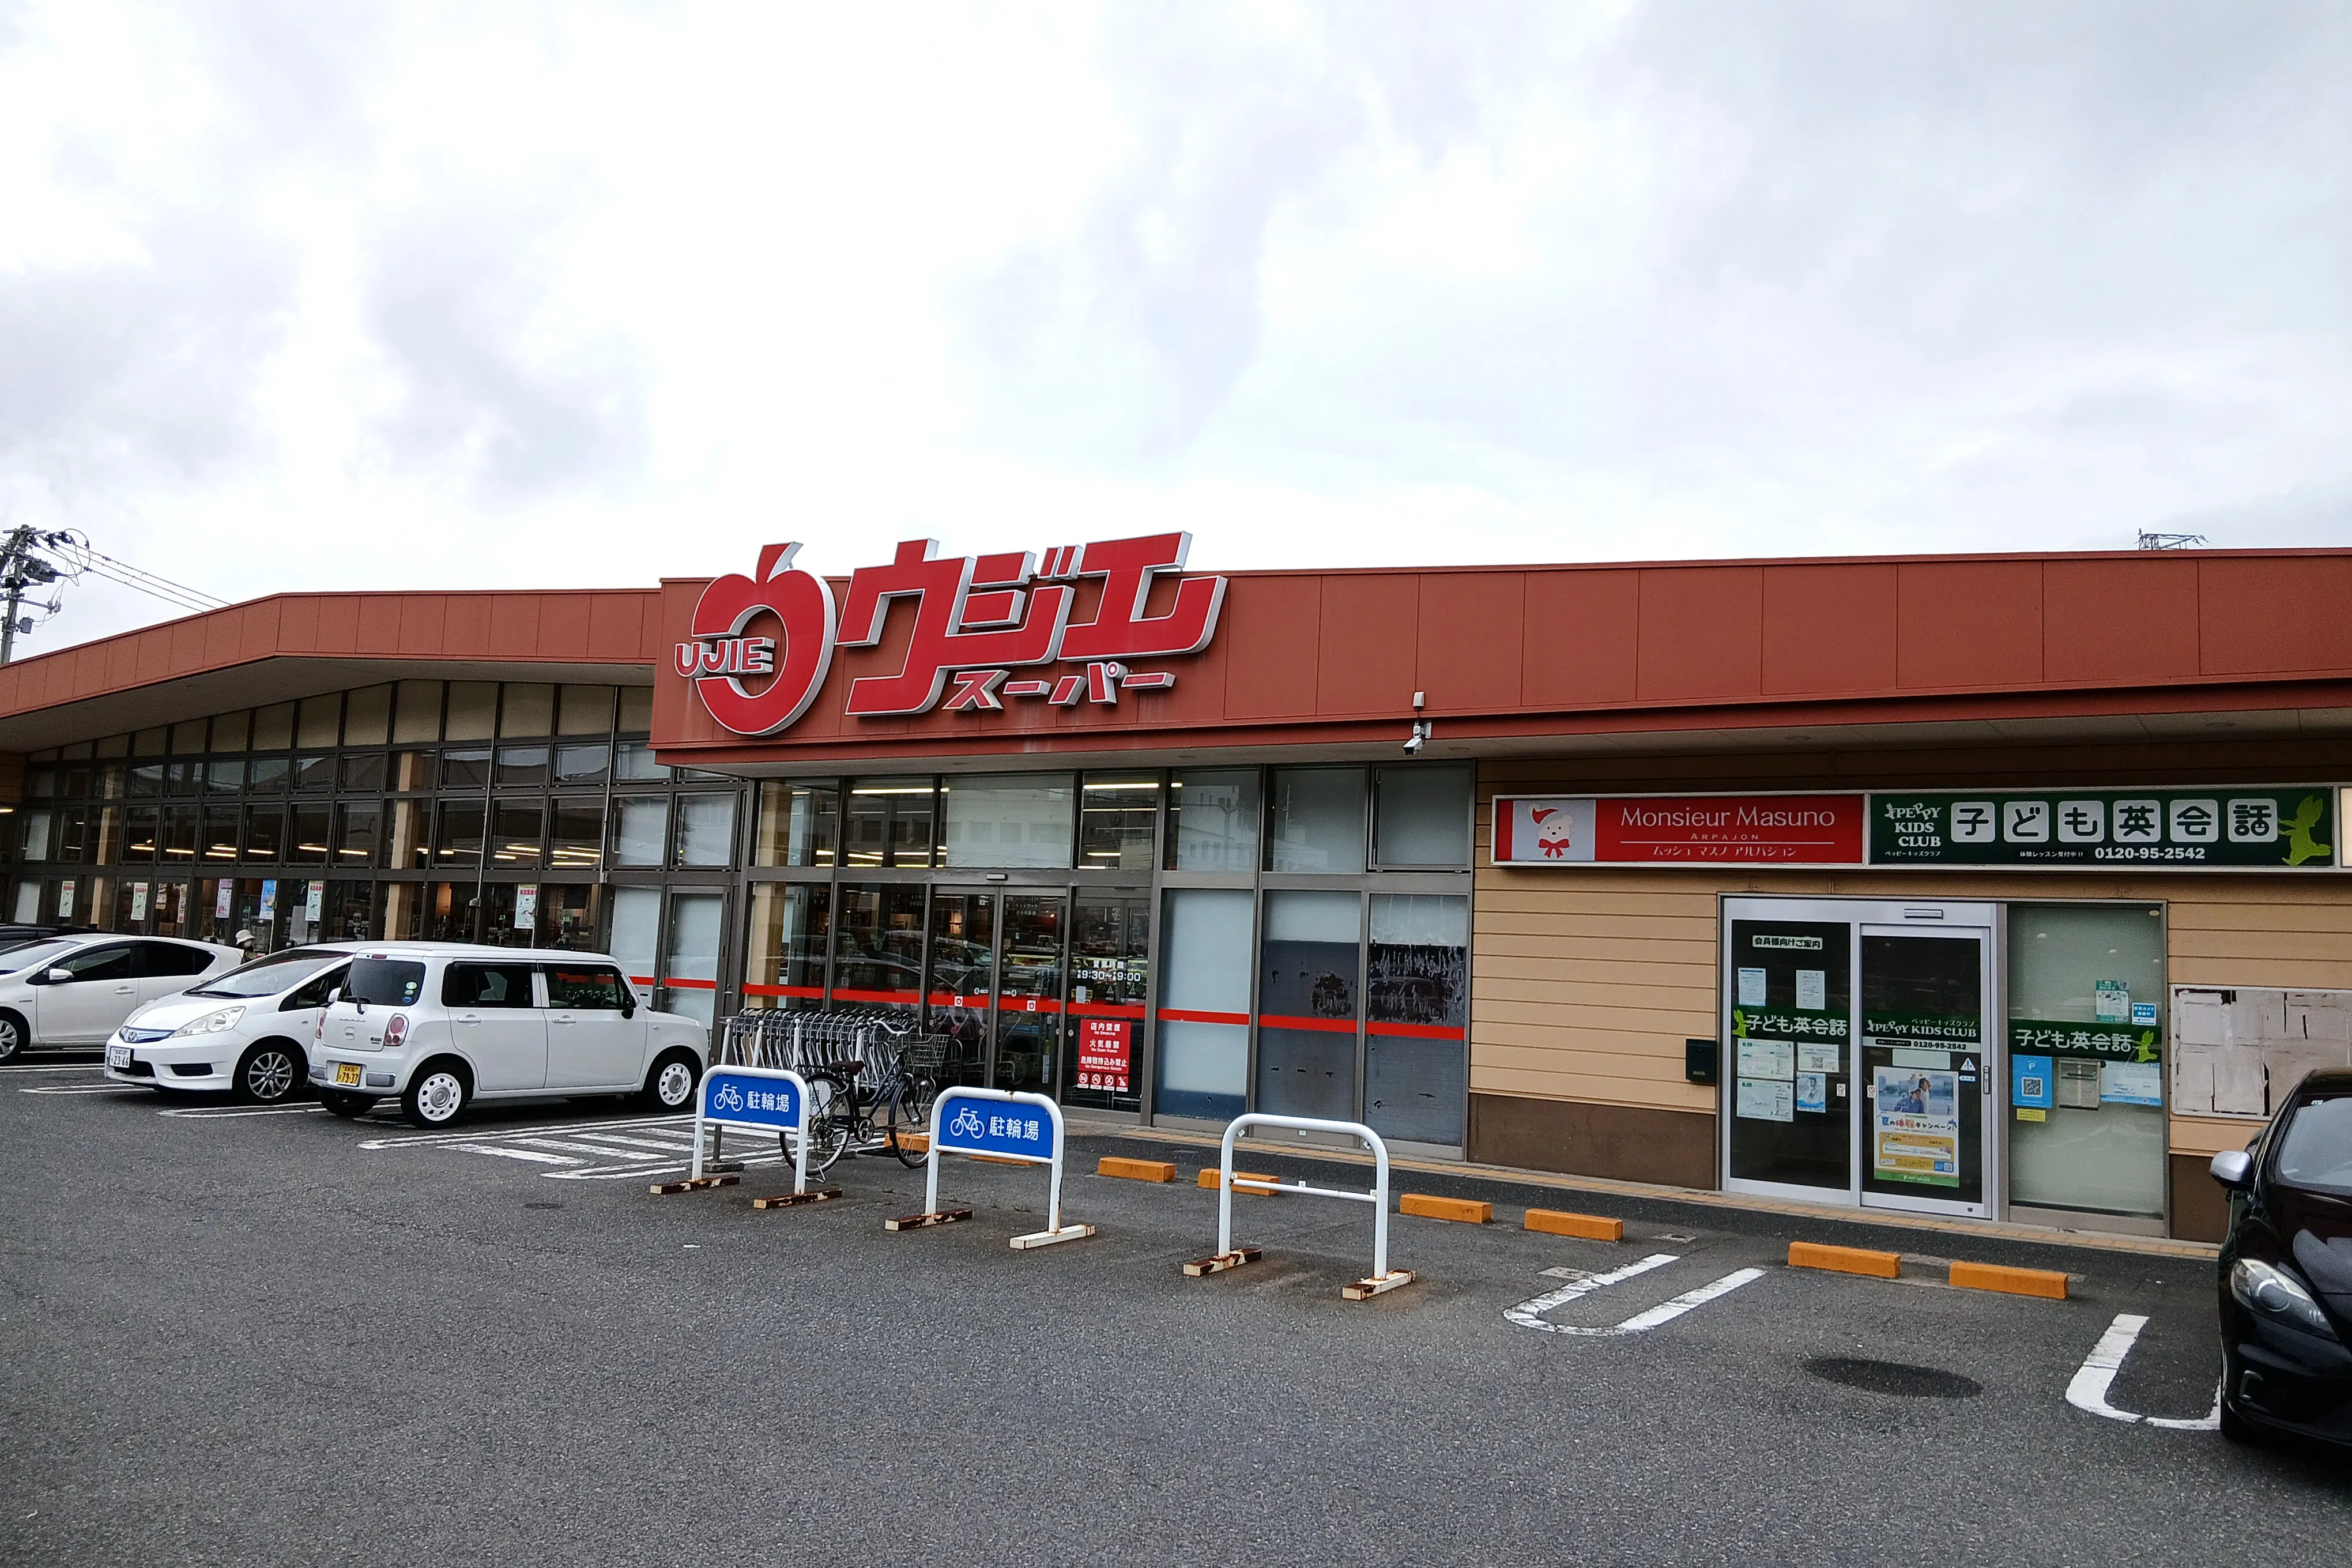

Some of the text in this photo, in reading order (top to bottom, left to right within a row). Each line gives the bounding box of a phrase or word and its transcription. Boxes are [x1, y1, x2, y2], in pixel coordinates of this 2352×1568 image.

[834, 531, 1228, 715] ウジエ
[674, 636, 775, 678] UJIE
[942, 661, 1175, 711] スーパー
[1620, 806, 1835, 827] Monsieur Masuno
[1896, 802, 1942, 820] PEPPY
[1895, 822, 1935, 833] KIDS
[1956, 804, 2273, 838] 子ども英会話
[1690, 832, 1759, 840] ARPAJON
[1898, 836, 1942, 847] CLUB
[1698, 846, 1728, 857] マスノ
[2094, 847, 2206, 860] 0120-95-2542
[1754, 937, 1820, 948] 会員様向けご案内
[1746, 1015, 1848, 1036] 子ども英会話
[1875, 1020, 1977, 1037] PEPPY KIDS CLUB
[1913, 1041, 1967, 1050] 0120-95-2542
[2015, 1029, 2132, 1053] 子ども英会話
[747, 1091, 790, 1113] 駐輪場
[989, 1116, 1039, 1141] 駐輪場
